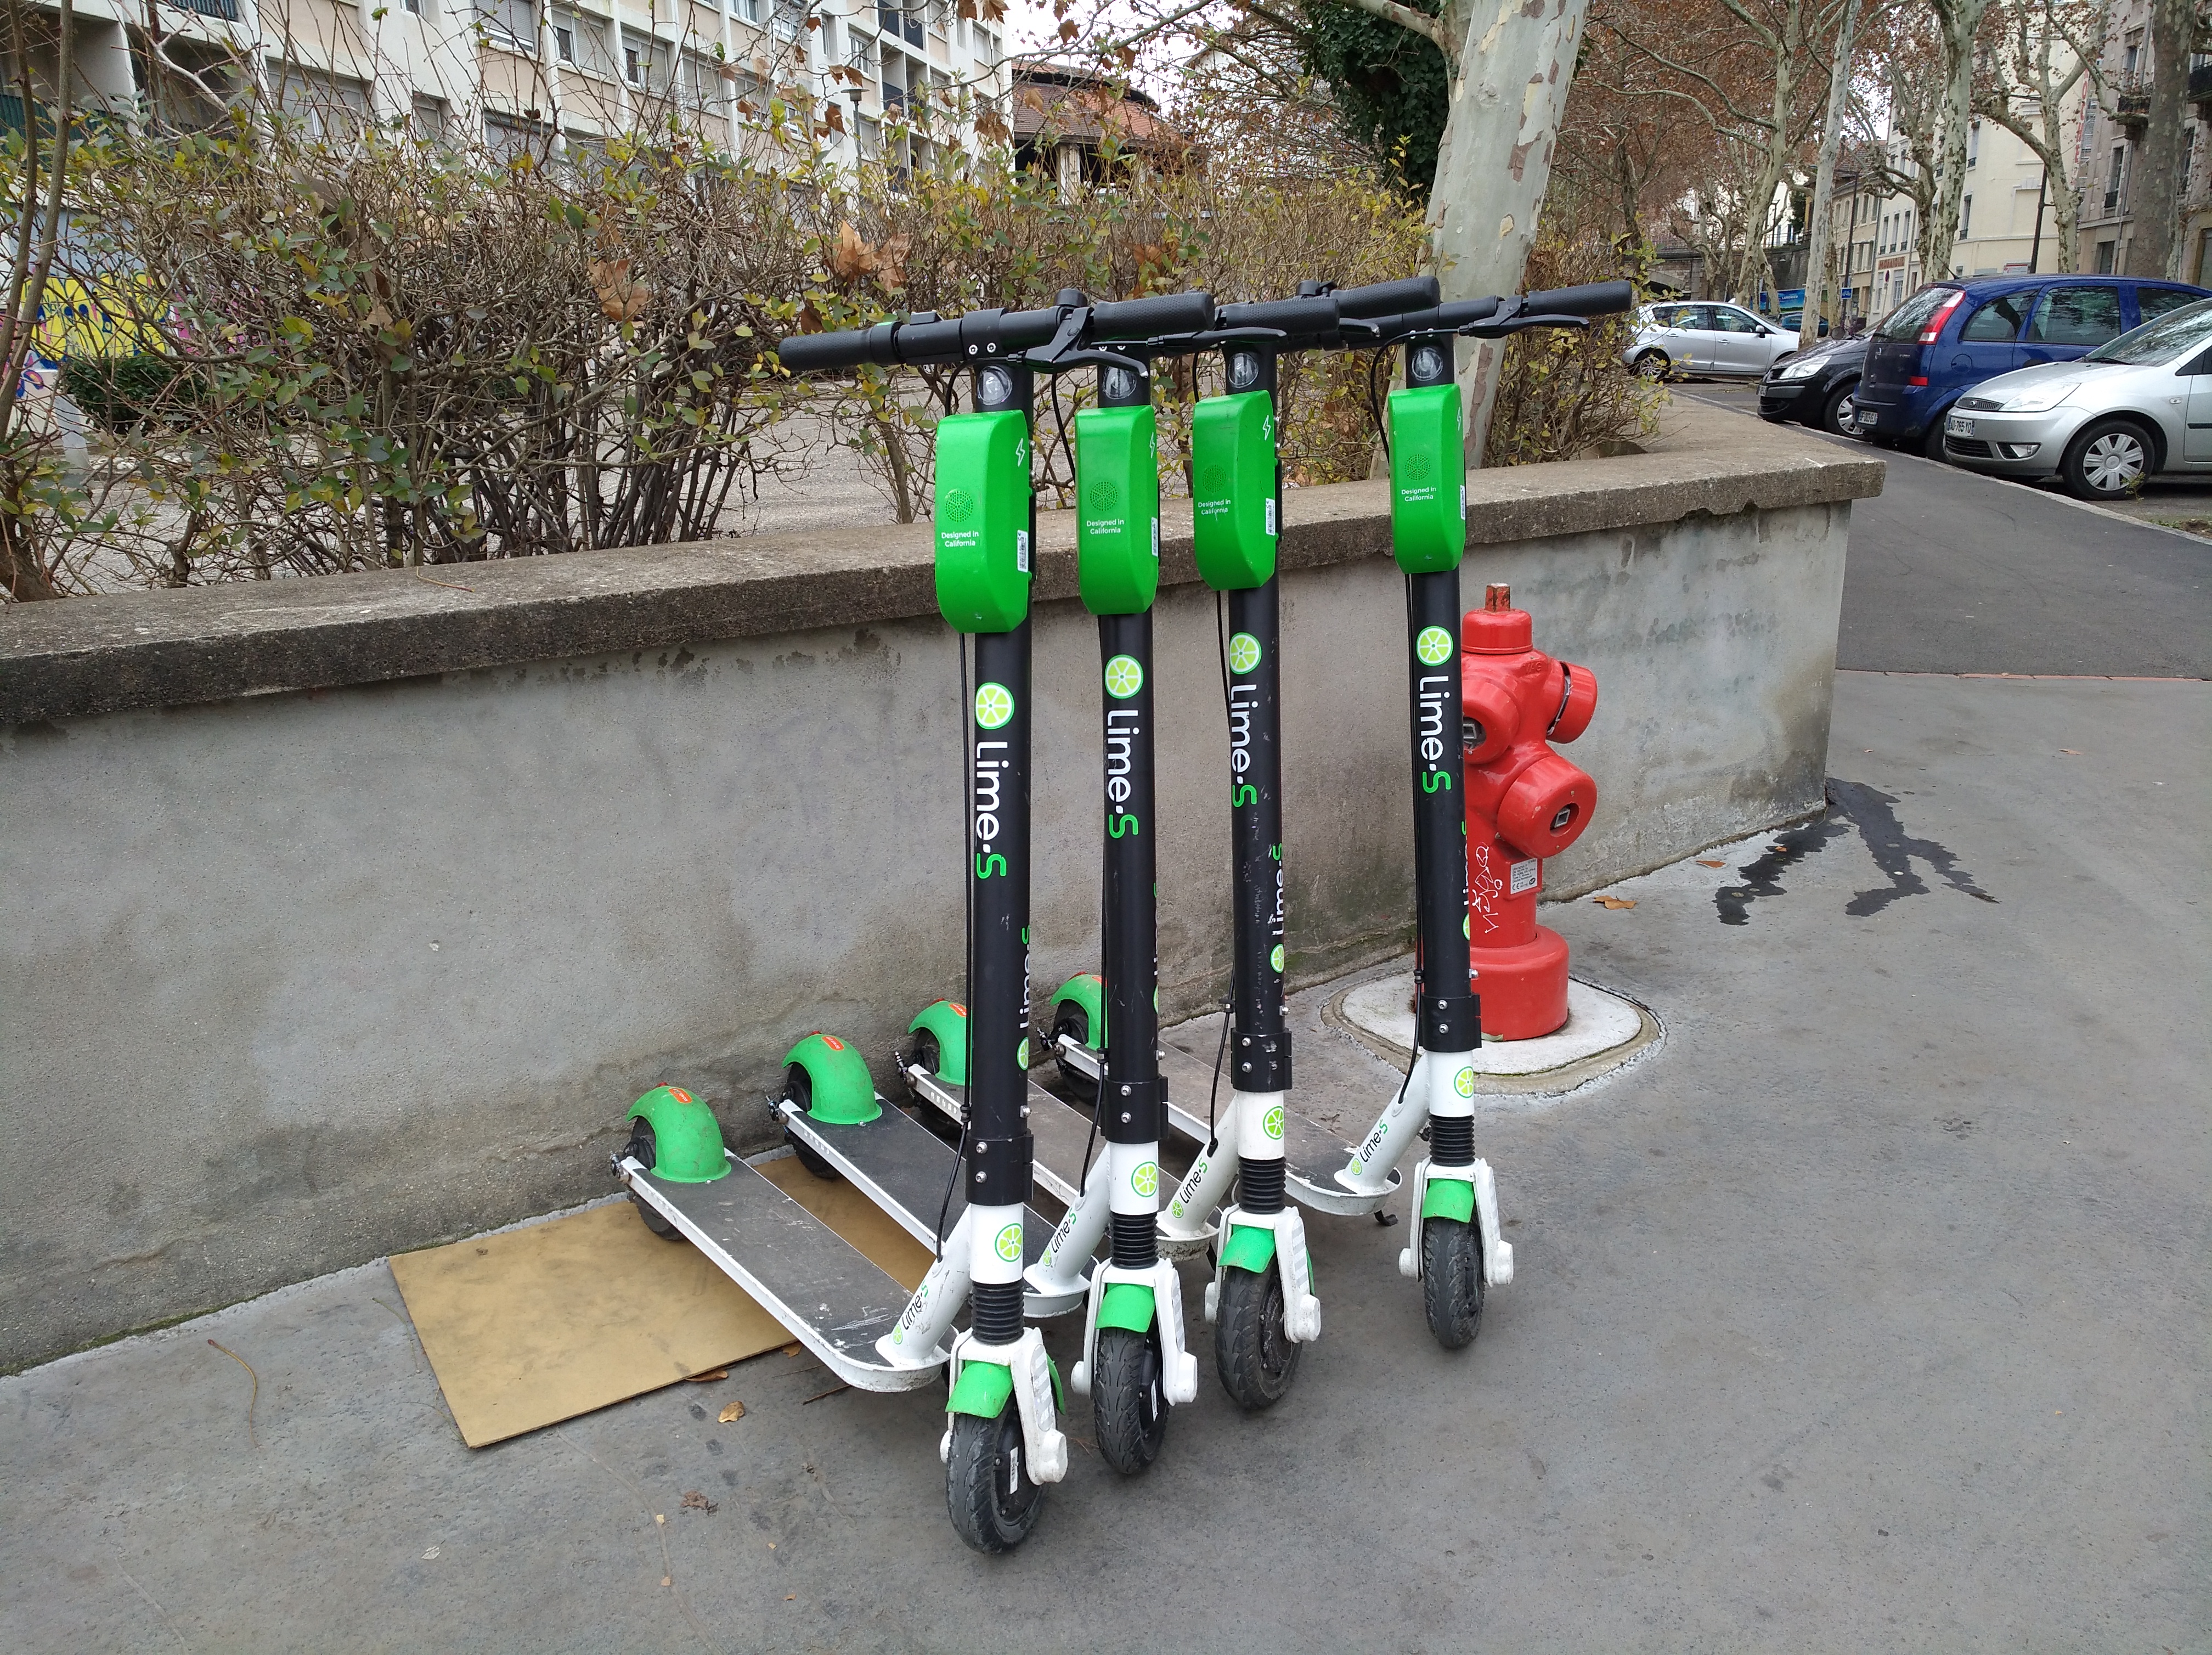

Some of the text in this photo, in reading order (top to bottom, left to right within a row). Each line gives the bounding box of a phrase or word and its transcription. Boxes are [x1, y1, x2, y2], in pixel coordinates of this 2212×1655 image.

[1198, 499, 1224, 508] Designed
[1086, 519, 1116, 527] Designed
[941, 531, 972, 539] Designed
